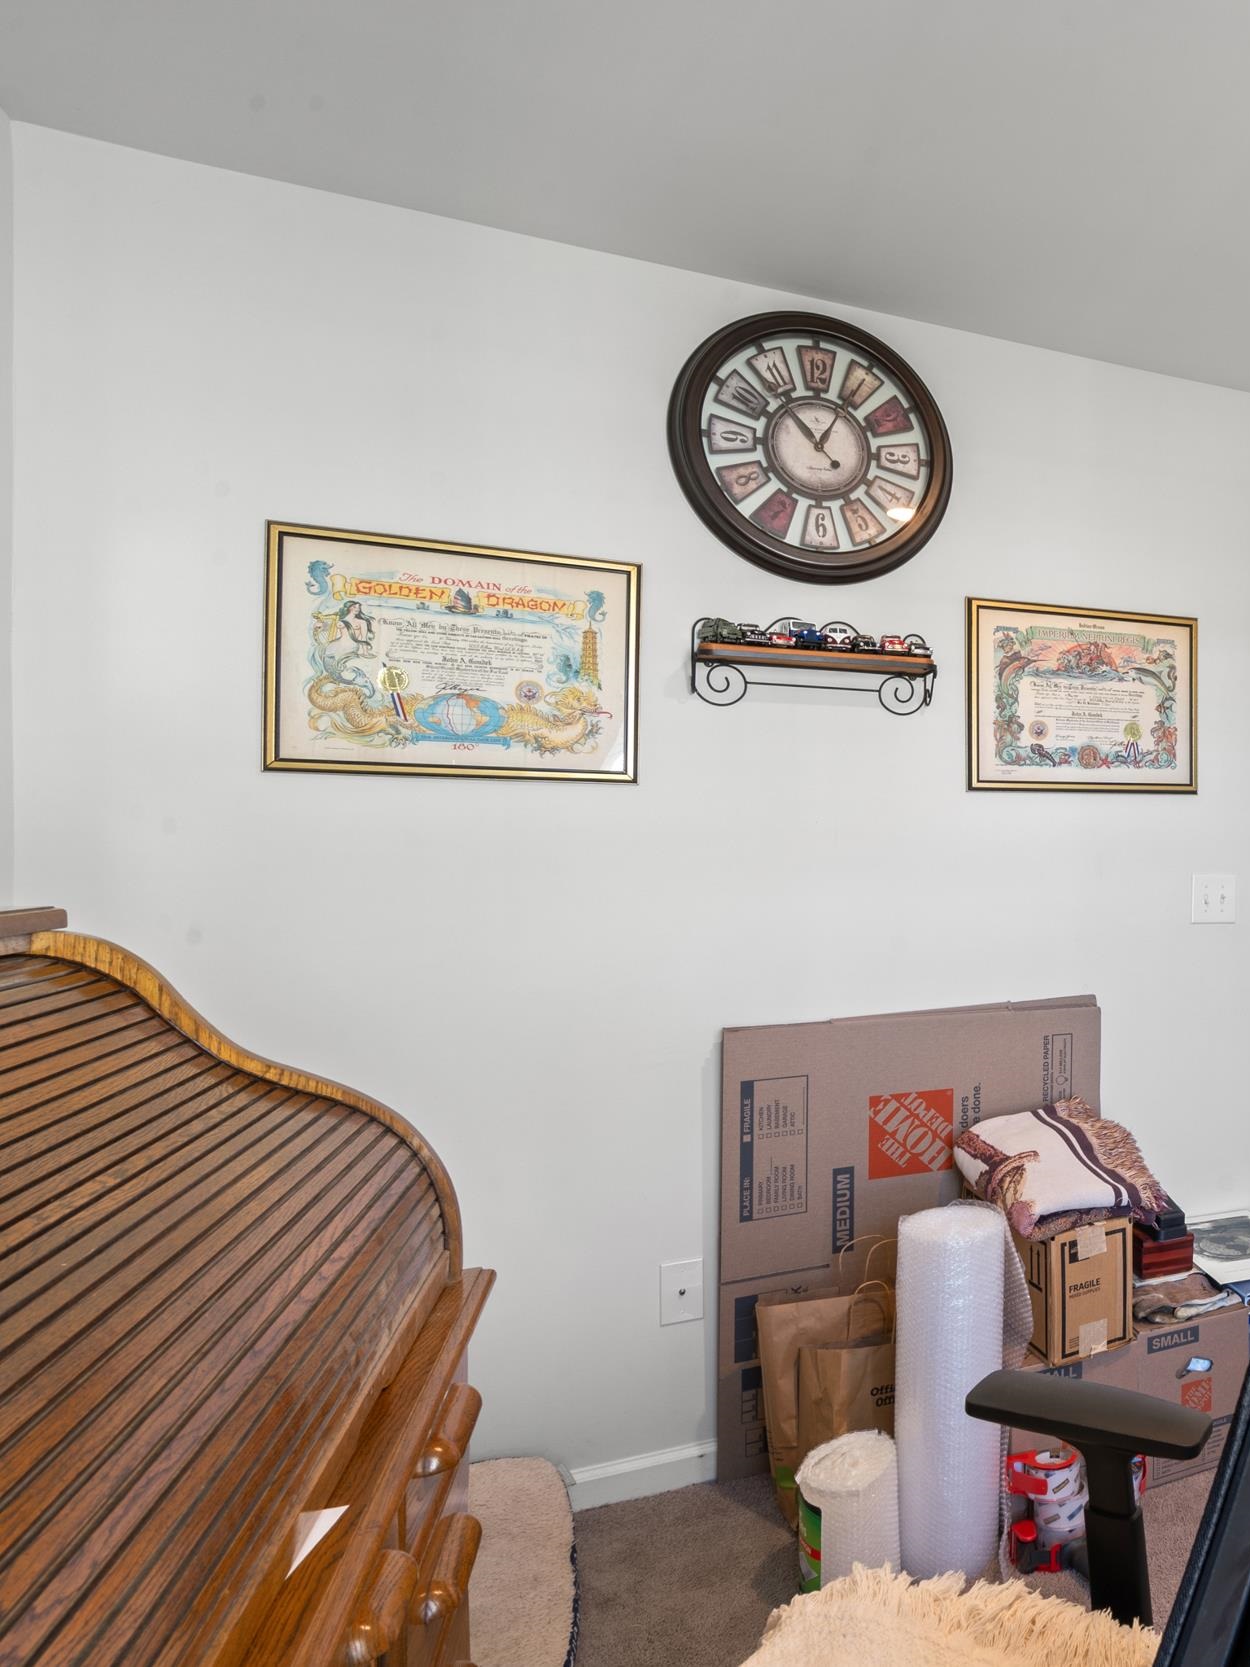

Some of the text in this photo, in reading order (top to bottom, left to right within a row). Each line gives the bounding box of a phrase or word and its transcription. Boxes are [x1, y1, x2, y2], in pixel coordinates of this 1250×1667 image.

[765, 360, 789, 389] 11
[809, 357, 828, 385] 12
[731, 386, 760, 412] 10
[720, 430, 748, 444] 9
[884, 451, 910, 465] 3
[735, 470, 760, 486] 8
[878, 484, 901, 503] 4
[815, 512, 827, 538] 6
[355, 580, 569, 612] GOLDEN DRAGON
[400, 572, 424, 584] The
[430, 576, 502, 592] DOMAIN
[1042, 1061, 1050, 1102] RECYCLED
[960, 1096, 969, 1128] doers
[972, 1082, 982, 1114] done.
[743, 1098, 751, 1132] FRAGILE
[901, 1092, 953, 1139] DEPOT
[869, 1095, 953, 1172] HOME
[878, 1135, 912, 1168] THE
[742, 1177, 751, 1216] PLACE IN:
[836, 1174, 851, 1247] MEDIUM
[1069, 1277, 1101, 1293] FRAGILE
[1152, 1331, 1196, 1350] SMALL
